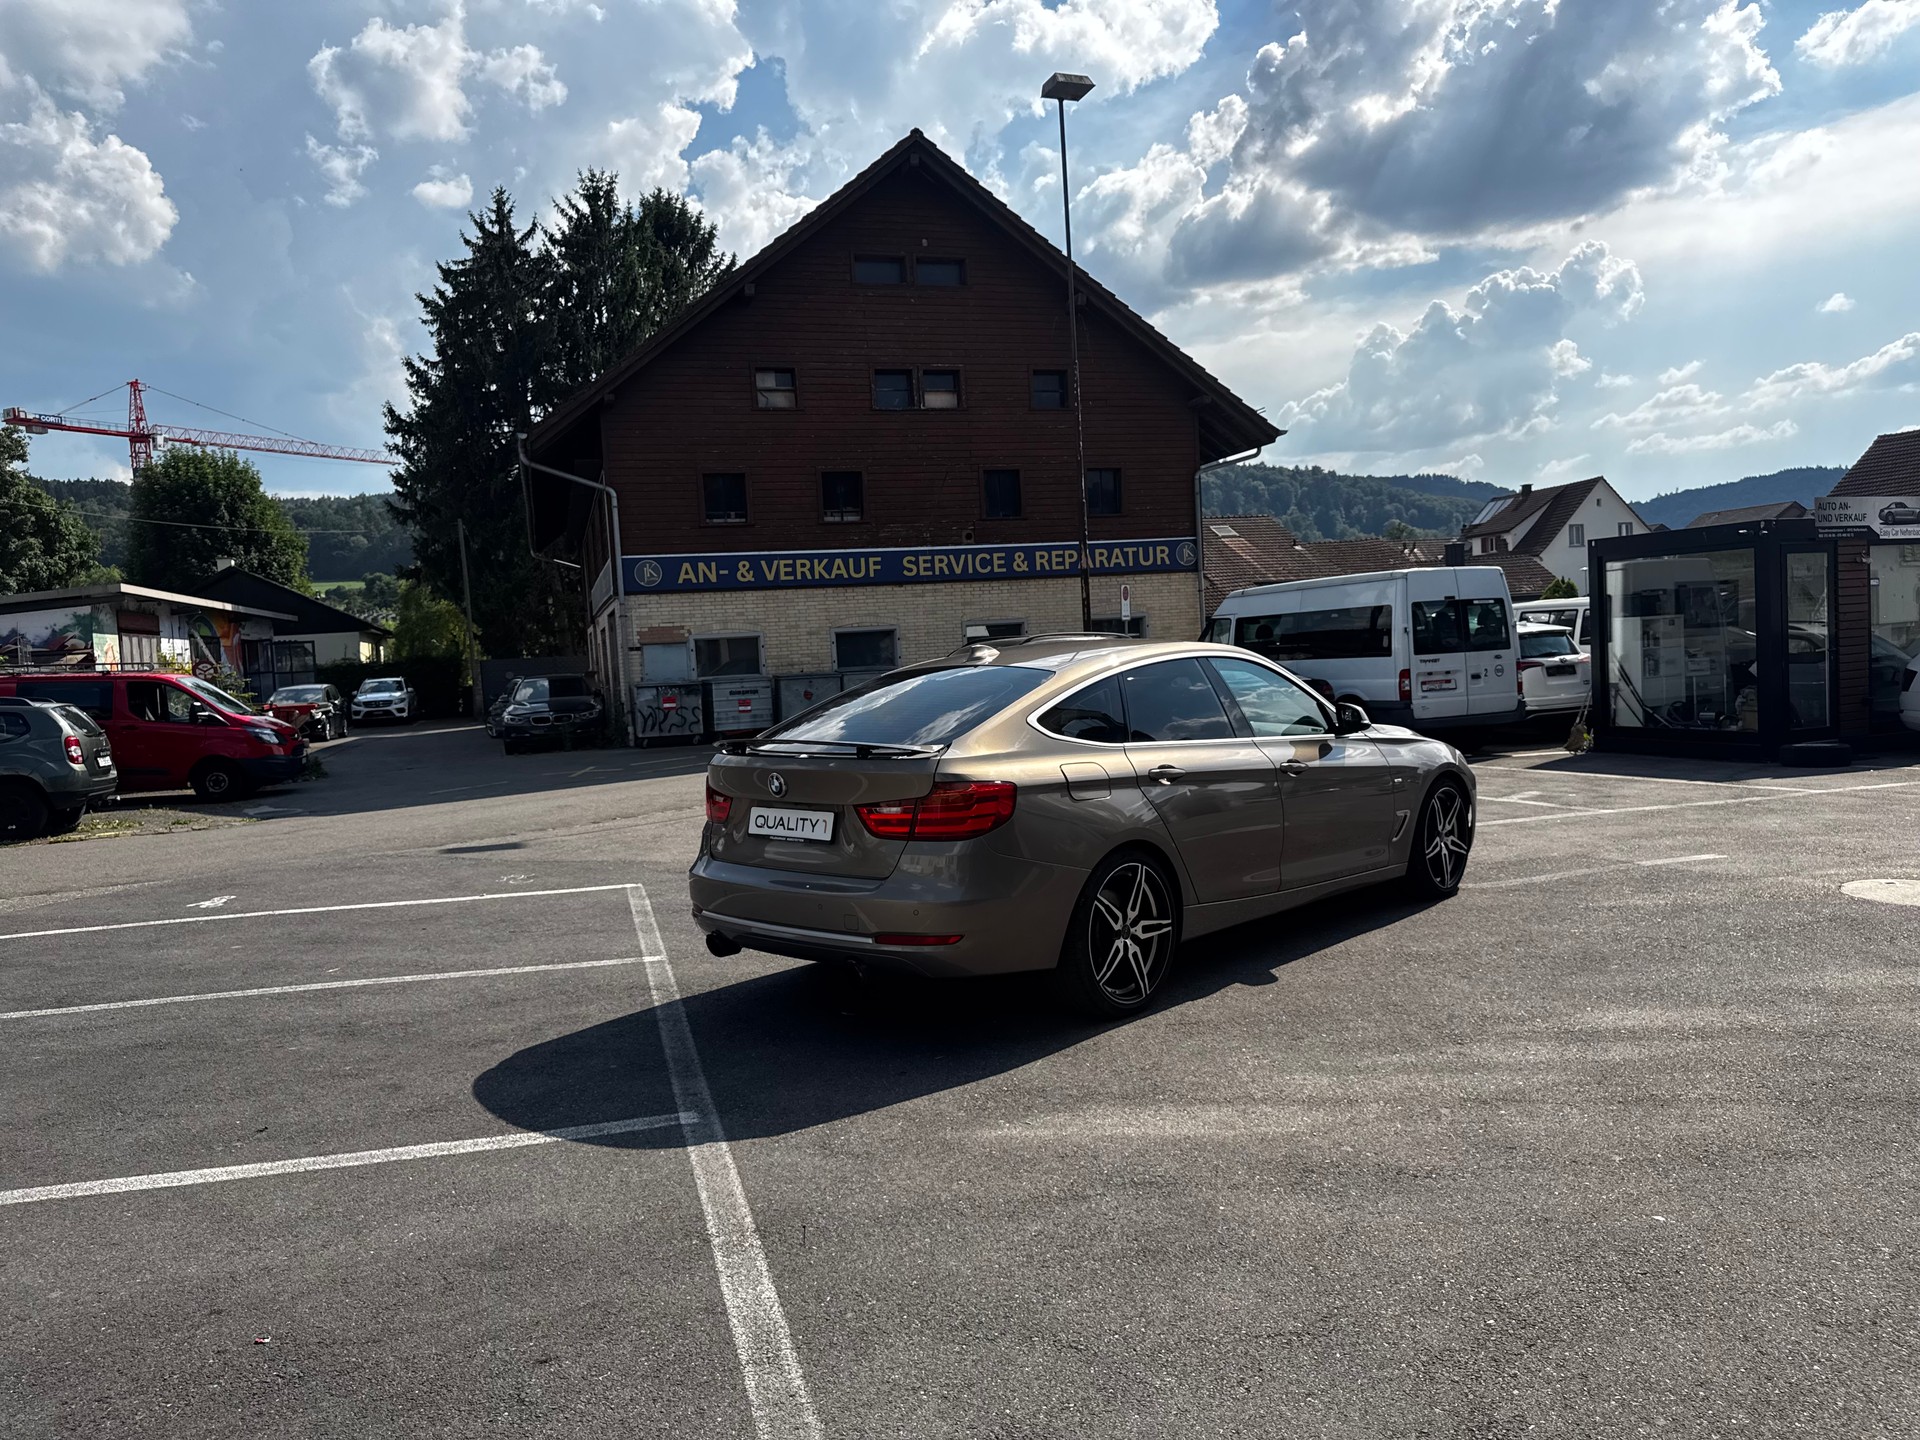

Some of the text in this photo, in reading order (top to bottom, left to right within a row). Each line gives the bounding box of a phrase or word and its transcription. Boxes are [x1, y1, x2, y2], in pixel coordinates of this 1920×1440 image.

[40, 415, 61, 424] CORTI
[1818, 501, 1851, 511] AUTO AN-
[1818, 512, 1867, 523] UND VERKAUF
[1880, 528, 1890, 538] Easy
[1891, 528, 1899, 536] Car
[678, 561, 729, 584] AN-
[735, 560, 755, 582] &
[760, 556, 882, 581] VERKAUF
[902, 552, 1006, 577] SERVICE
[1012, 551, 1029, 573] &
[1484, 668, 1489, 678] 2
